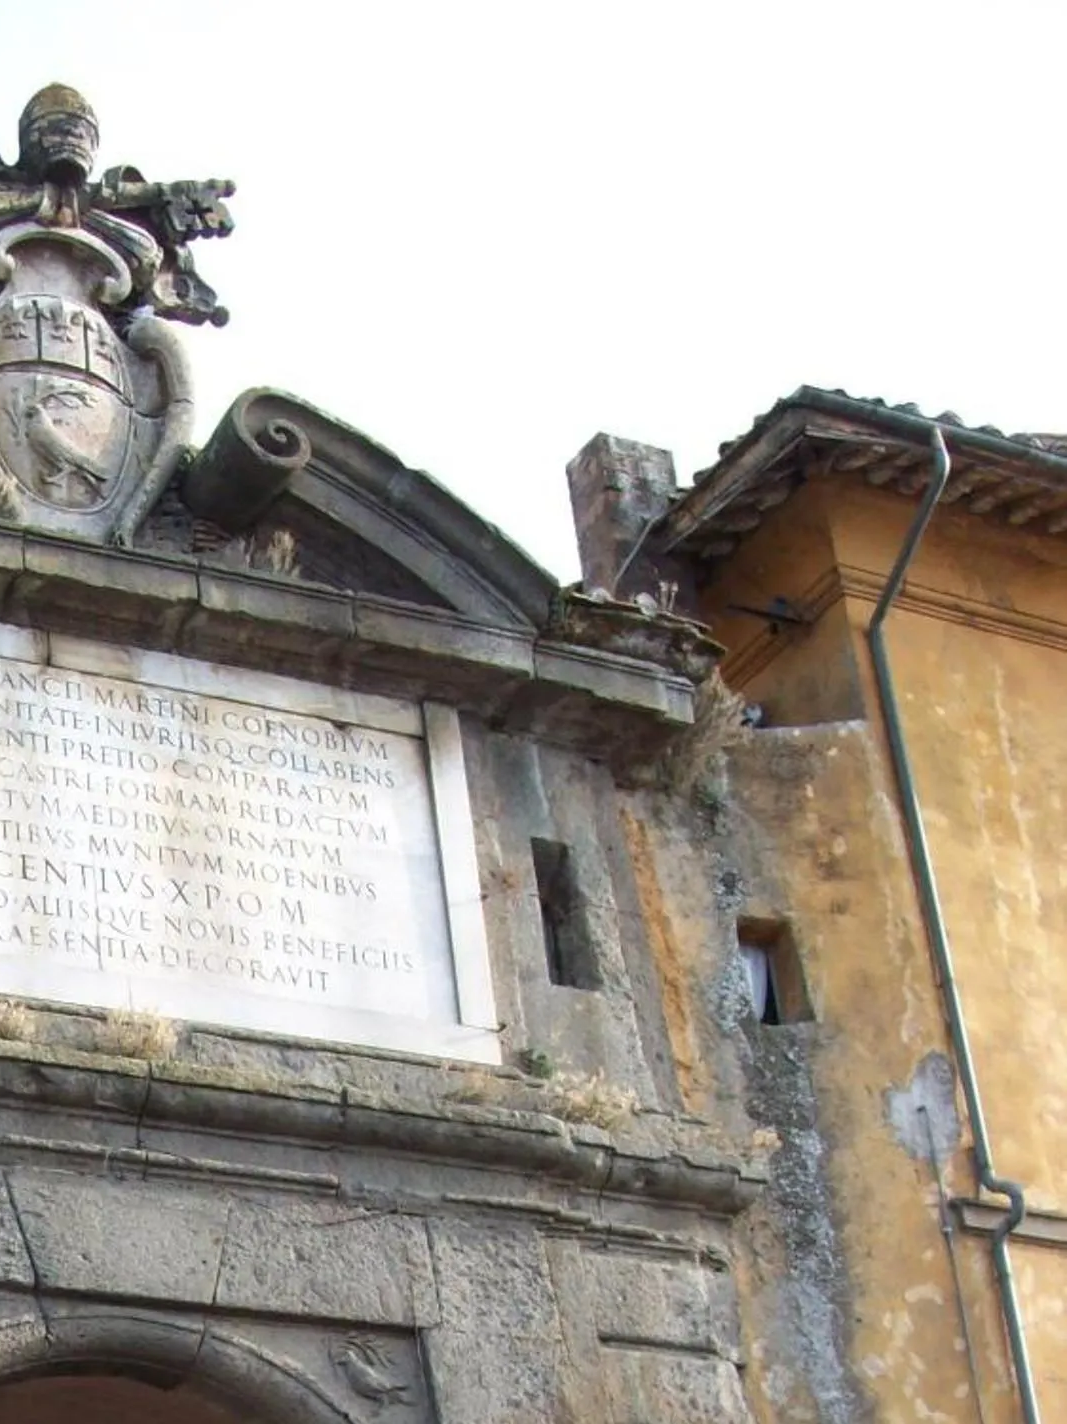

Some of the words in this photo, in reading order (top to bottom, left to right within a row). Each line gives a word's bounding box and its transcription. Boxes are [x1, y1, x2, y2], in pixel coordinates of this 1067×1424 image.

[94, 686, 210, 725] MARTINI
[222, 711, 389, 761] COENOBIVM
[61, 738, 159, 773] PRETIO
[172, 758, 369, 812] COMPARATVM
[248, 744, 395, 789] COLLABENS
[72, 804, 191, 837] AEDIBVS
[204, 823, 343, 866] ORNATVM
[105, 775, 227, 814] FORMAM
[239, 799, 387, 844] REDACTVM
[89, 834, 224, 875] MVNITVM
[236, 859, 377, 900] MOENIBVS
[22, 895, 152, 937] ALIISQVE
[164, 912, 250, 947] NOVIS
[263, 930, 414, 973] BENEFICIIS
[170, 878, 190, 906] X
[281, 897, 306, 925] M
[160, 945, 329, 991] DECORAVIT
